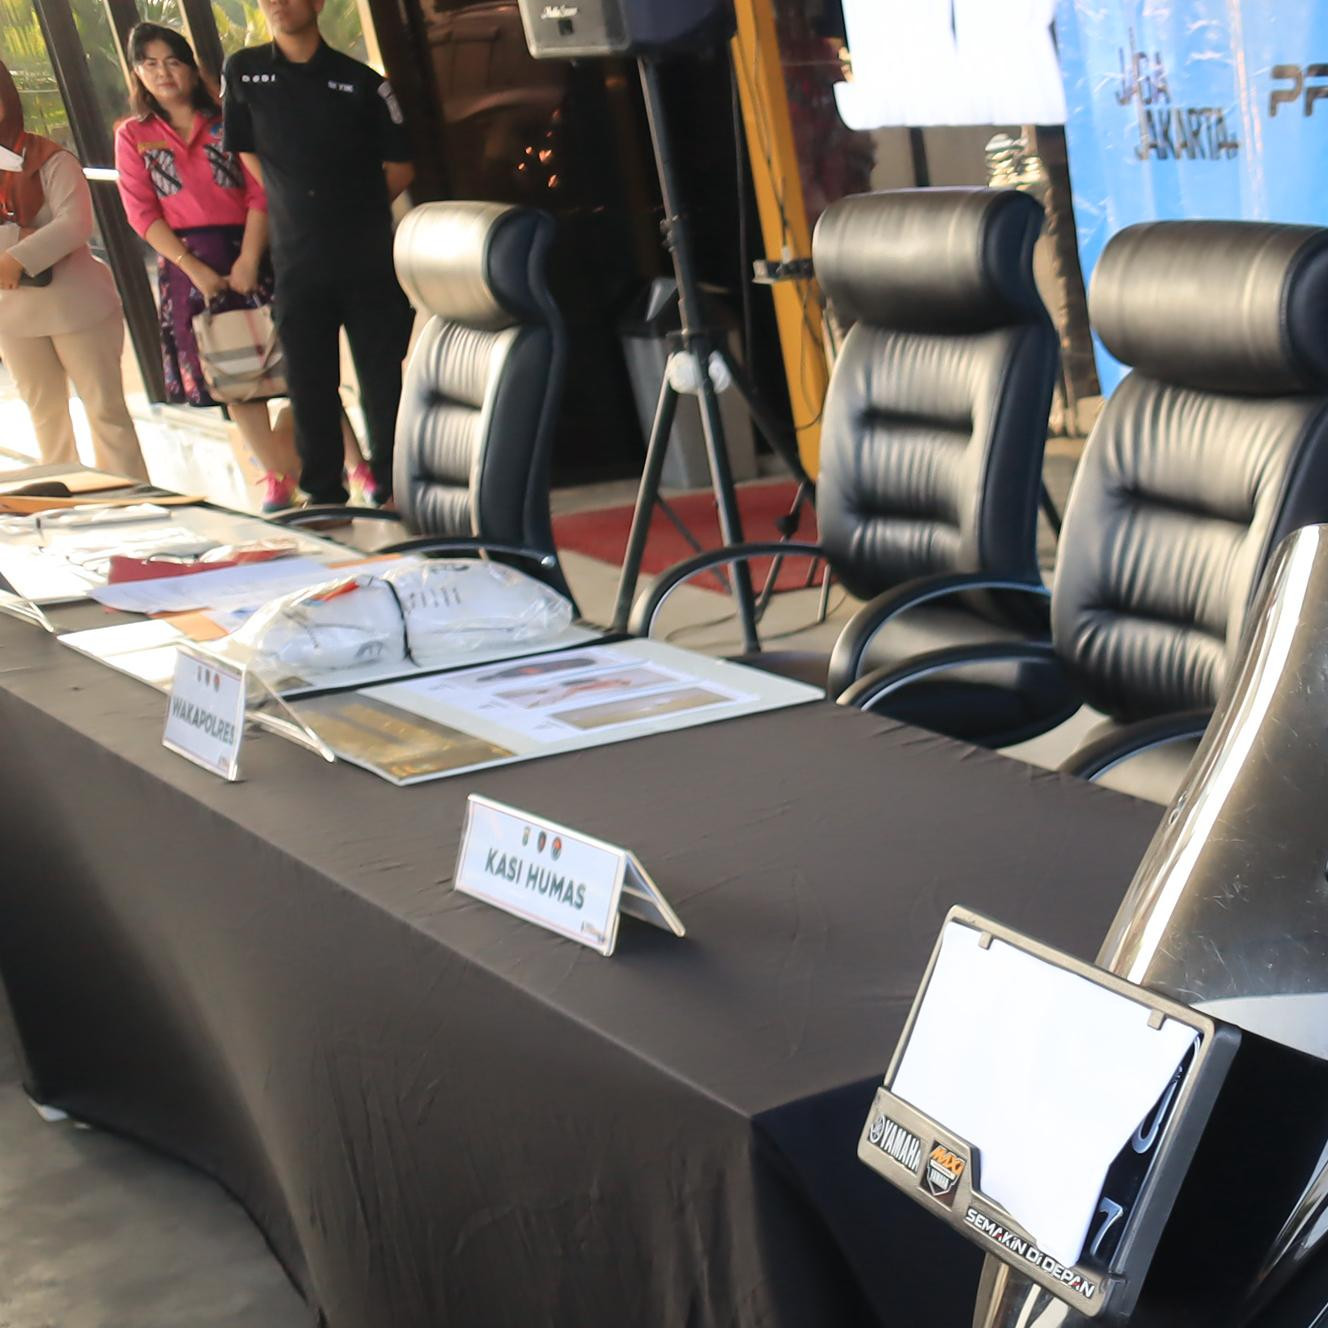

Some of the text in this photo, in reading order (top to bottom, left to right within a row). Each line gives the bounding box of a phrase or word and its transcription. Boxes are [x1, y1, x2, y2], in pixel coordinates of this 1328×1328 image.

[171, 697, 236, 746] WAKAPOLRES
[484, 848, 587, 910] KASI HUMAS
[880, 1119, 921, 1173] YAMAHA
[1042, 1258, 1096, 1299] DEPAN
